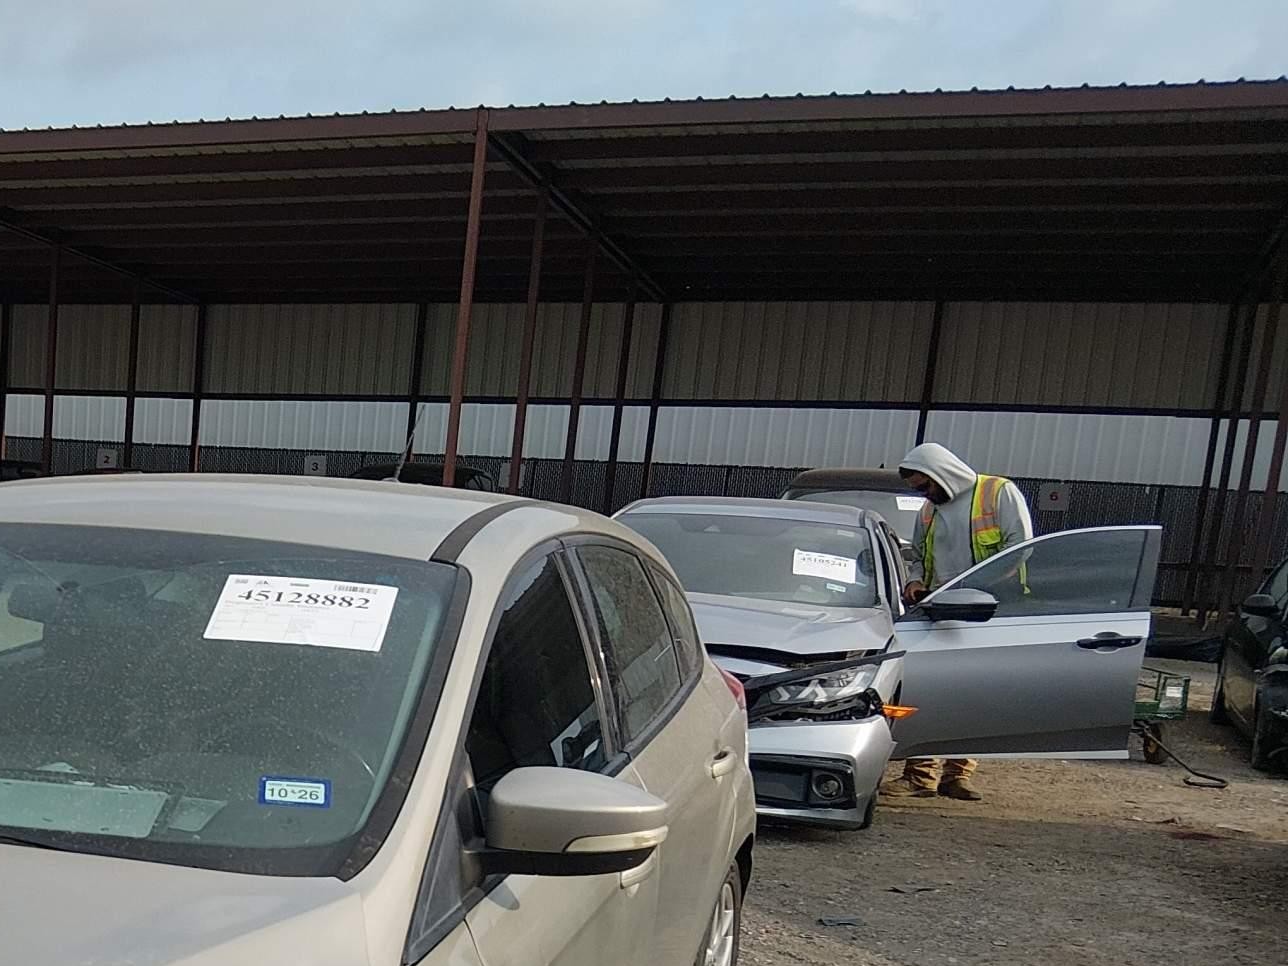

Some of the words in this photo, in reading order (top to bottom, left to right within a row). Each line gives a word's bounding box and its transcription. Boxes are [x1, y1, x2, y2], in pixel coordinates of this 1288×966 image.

[311, 462, 319, 471] 3
[237, 588, 371, 610] 45128882
[267, 787, 288, 798] 10
[297, 789, 320, 800] 26
